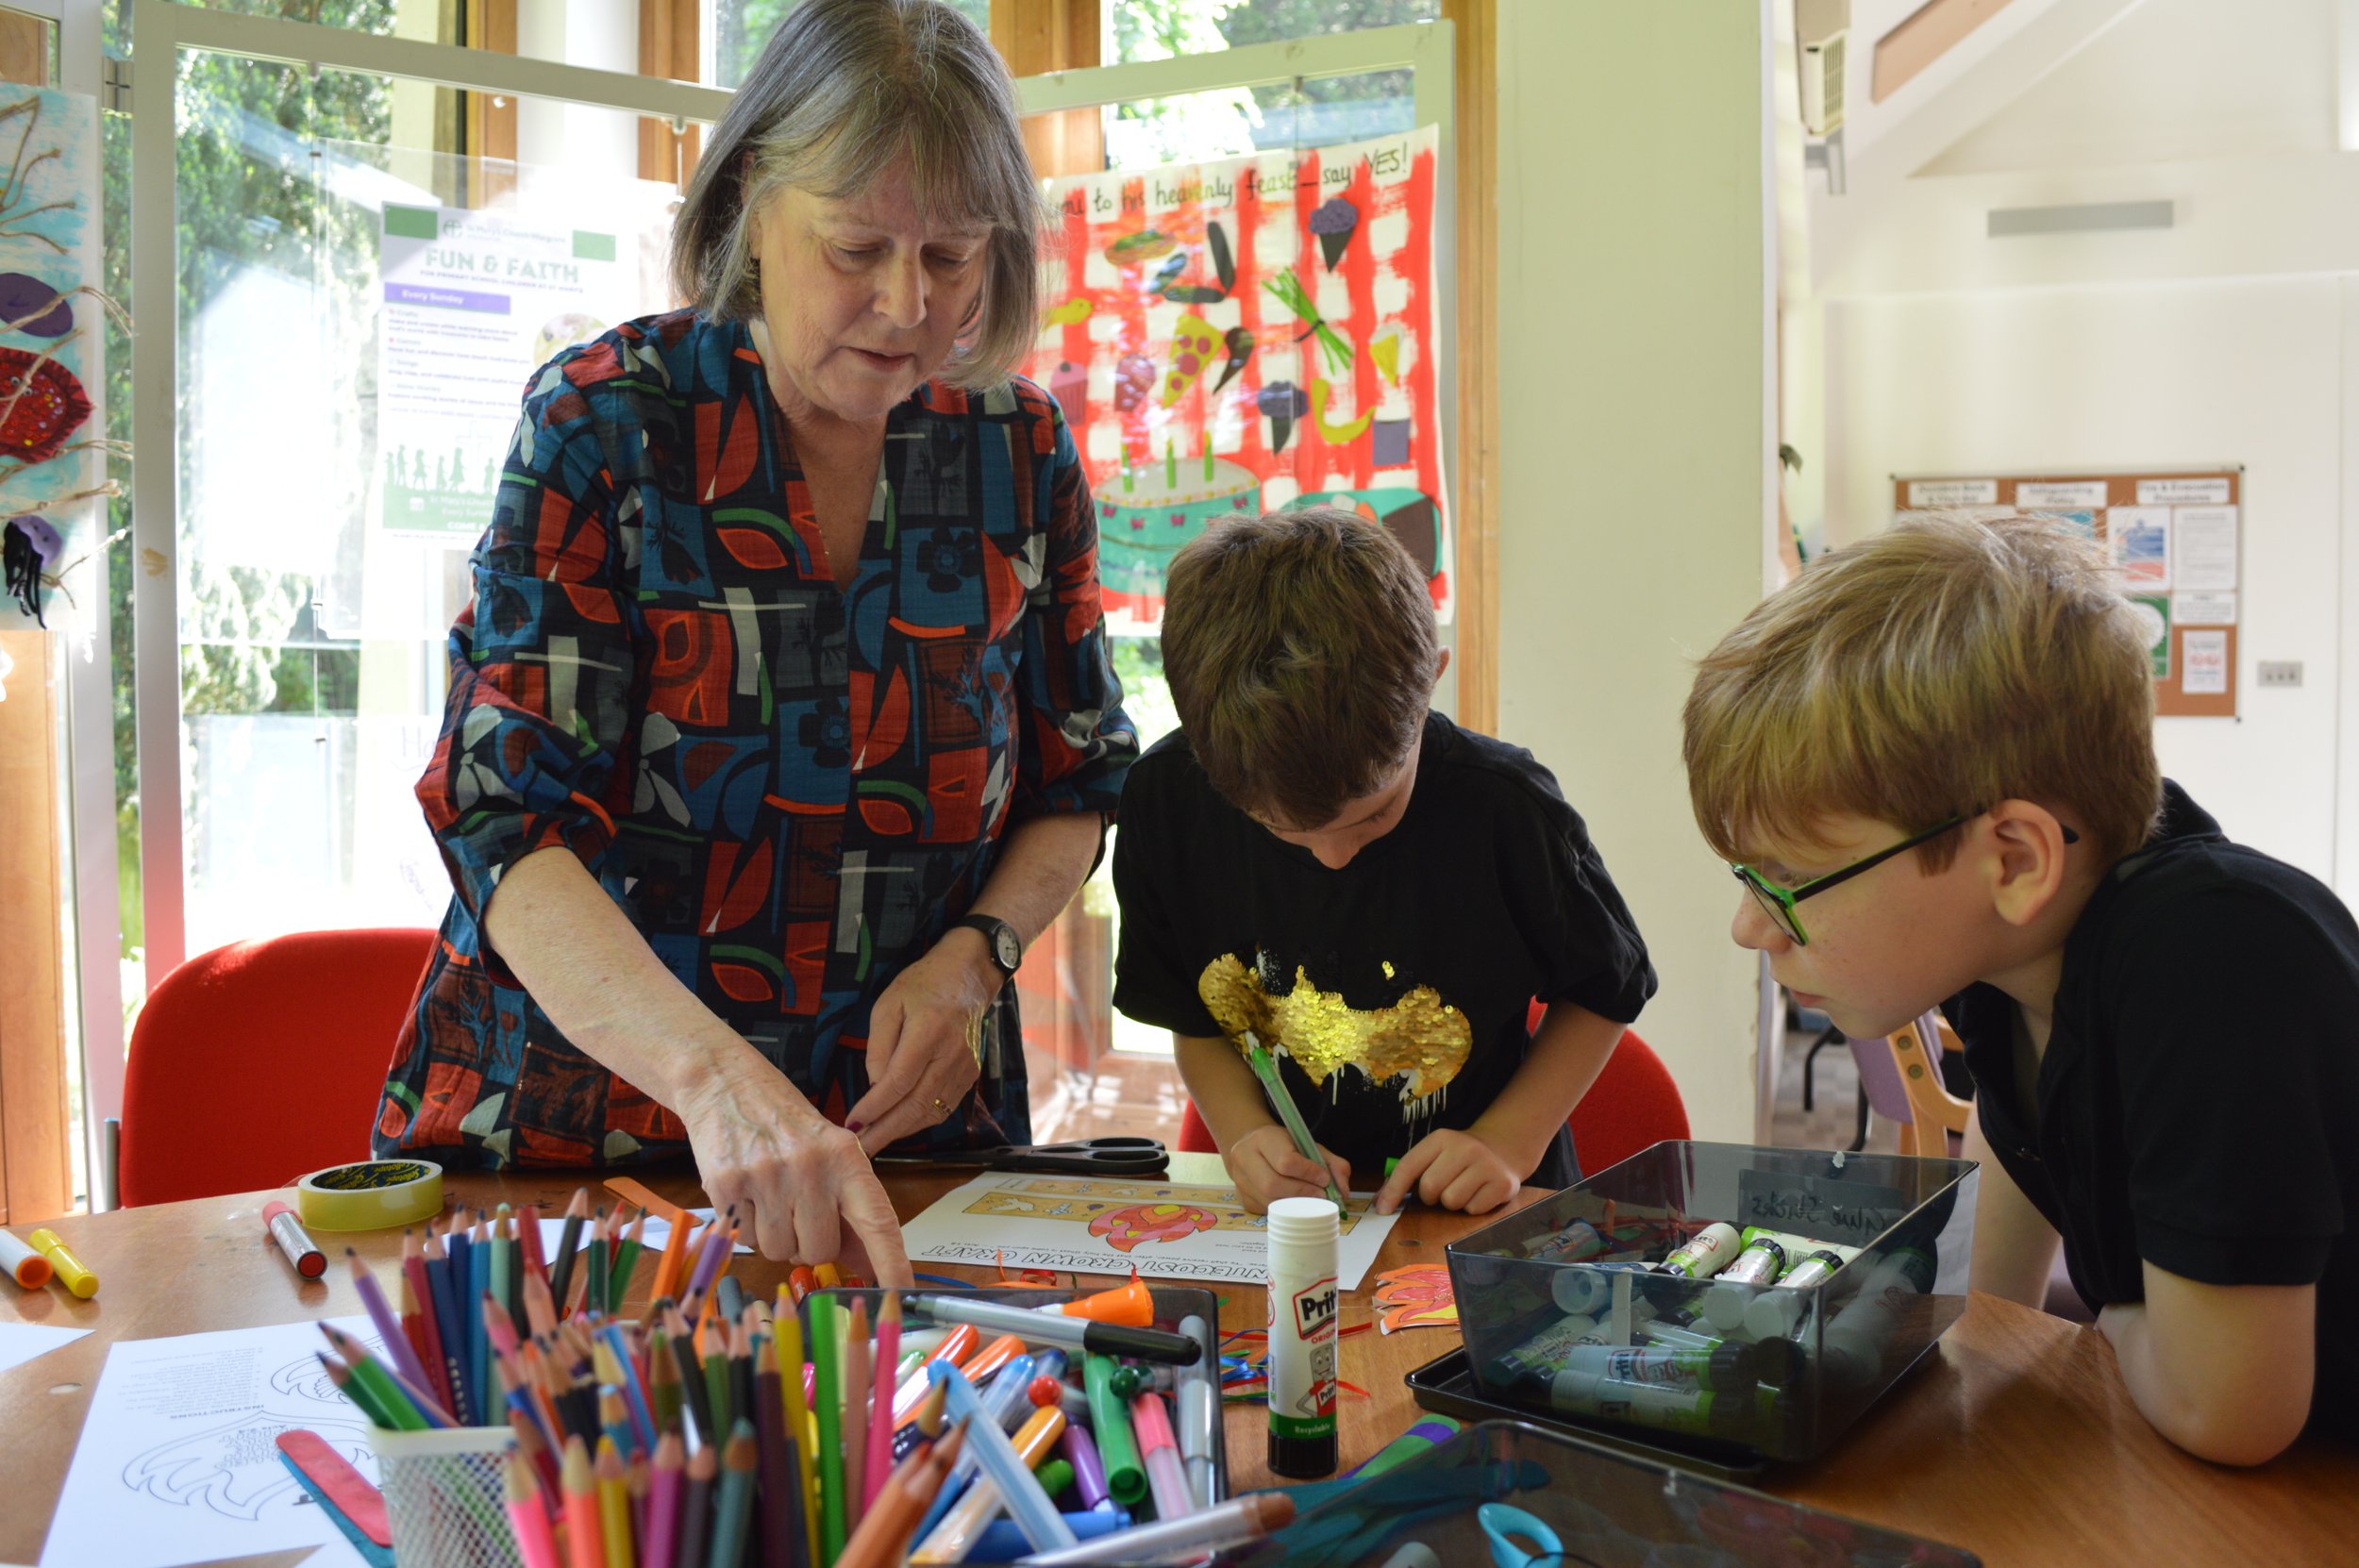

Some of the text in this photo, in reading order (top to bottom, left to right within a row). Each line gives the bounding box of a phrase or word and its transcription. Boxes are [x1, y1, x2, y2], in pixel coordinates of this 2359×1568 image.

[1093, 193, 1113, 213] to
[1121, 186, 1146, 211] his
[1155, 175, 1232, 209] heavenly
[1246, 161, 1299, 200] feast
[1322, 163, 1352, 192] say
[1364, 141, 1409, 178] YES!
[426, 248, 579, 284] FUN & FAITH
[402, 288, 465, 307] Every Sunday
[385, 1168, 420, 1184] Sellotape
[921, 1244, 1269, 1280] NTECOST CROWN CRAFT
[170, 1403, 264, 1420] INSTRUCTIONS
[1295, 1423, 1331, 1435] Recyclable
